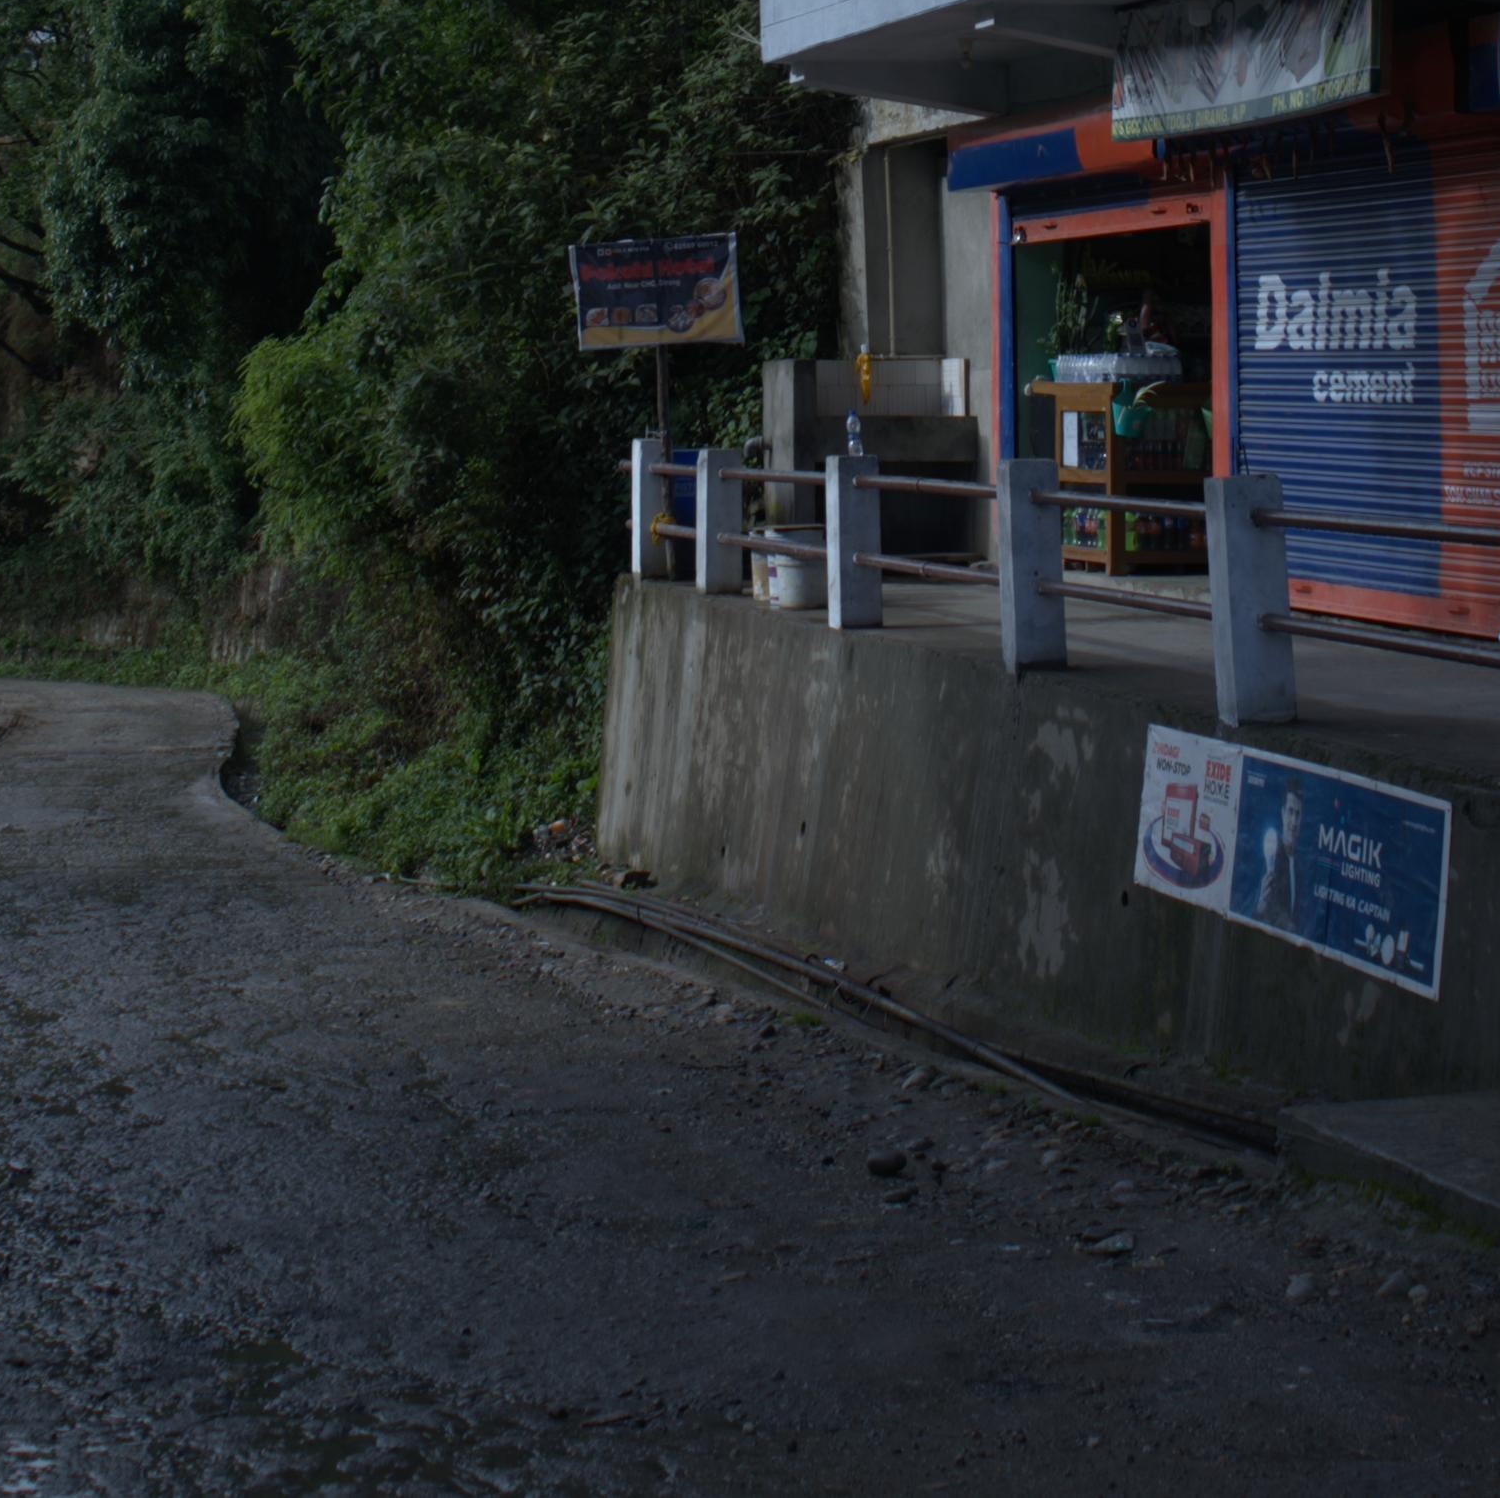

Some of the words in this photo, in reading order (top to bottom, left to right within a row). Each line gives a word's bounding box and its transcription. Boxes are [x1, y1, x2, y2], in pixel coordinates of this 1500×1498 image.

[1254, 267, 1418, 351] Dalmia
[1312, 361, 1416, 404] cement
[1156, 758, 1192, 777] NON-STOP
[1205, 759, 1232, 783] EXIDE
[1203, 779, 1232, 800] HOME
[1317, 822, 1384, 870] MAGIK
[1340, 861, 1381, 889] LIGHTING
